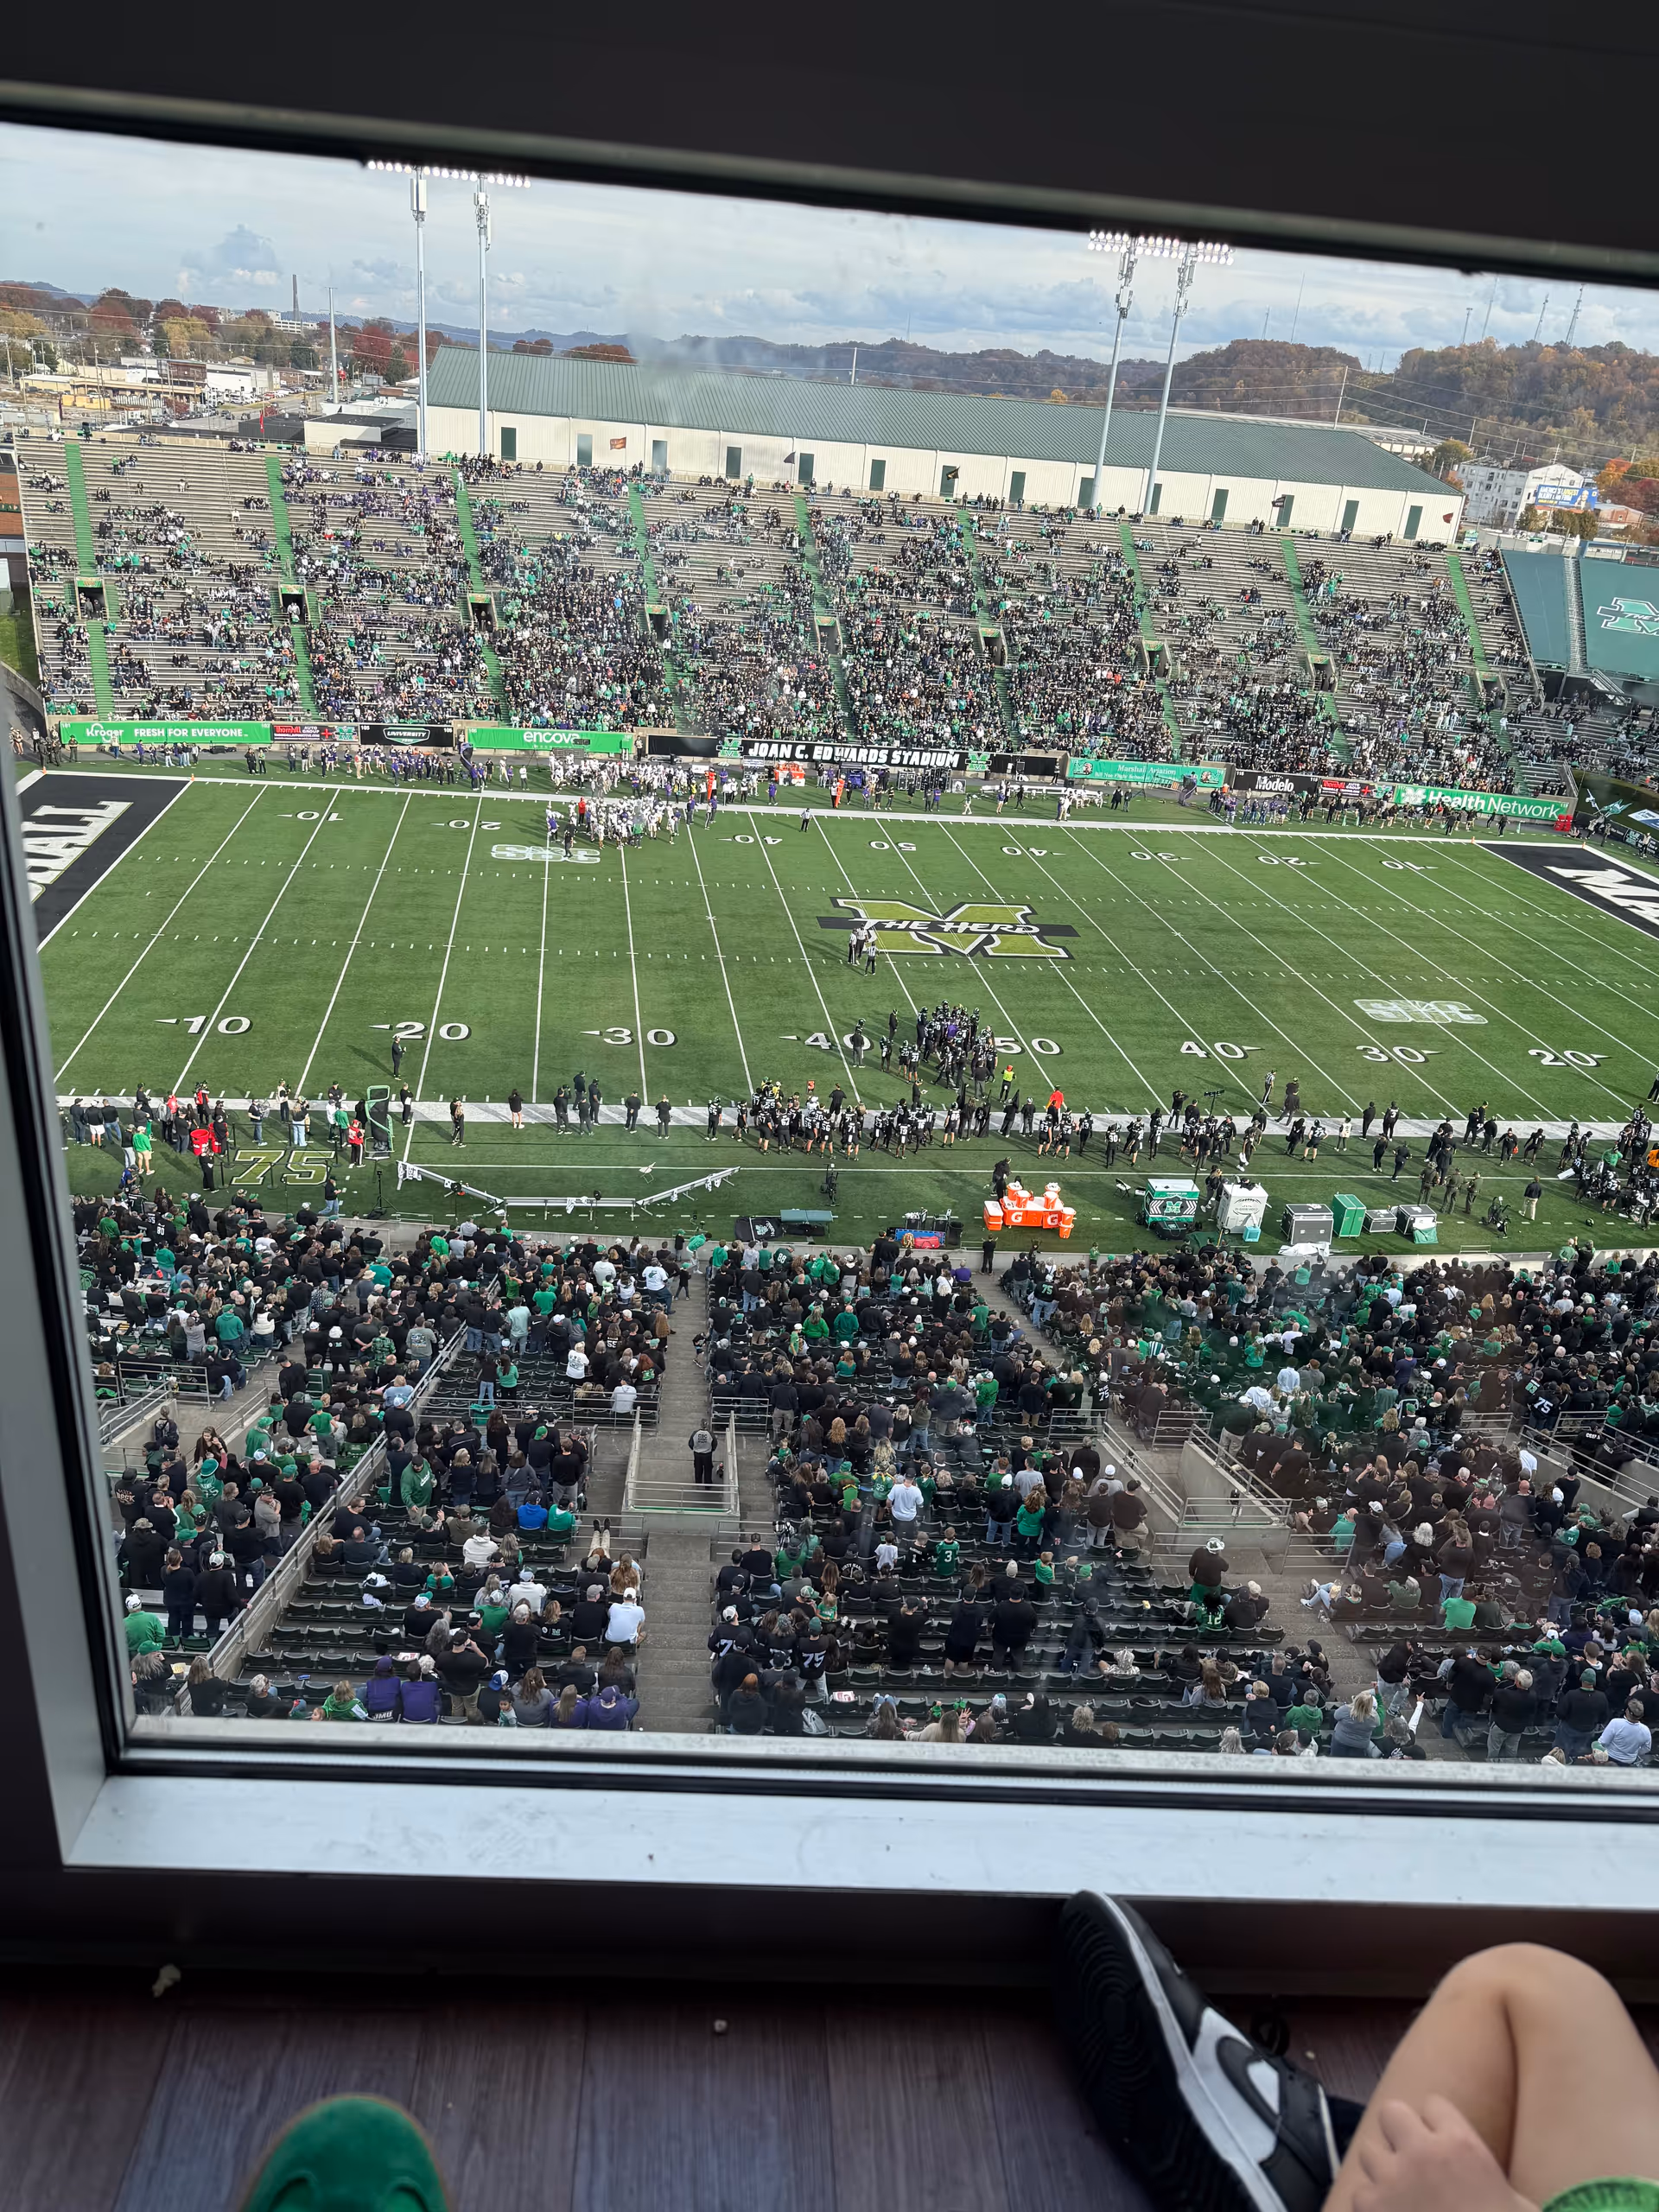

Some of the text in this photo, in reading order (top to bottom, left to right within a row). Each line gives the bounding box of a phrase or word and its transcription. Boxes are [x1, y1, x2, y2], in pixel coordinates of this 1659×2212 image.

[86, 723, 124, 742] Kroger
[134, 728, 244, 737] FRESH FOR EVERYONE
[524, 731, 580, 744] encova
[748, 742, 960, 767] JOAN C. EDWARDS STADIUM
[1255, 776, 1294, 792] Modelo
[1427, 791, 1560, 817] Health Network
[848, 918, 1040, 934] THE HERD
[231, 1149, 336, 1185] 75
[156, 1226, 165, 1236] 80
[777, 1252, 786, 1263] 88
[1041, 1284, 1053, 1295] 75
[1098, 1389, 1109, 1402] 75
[1534, 1396, 1554, 1414] 75
[944, 1550, 953, 1563] 3
[802, 1650, 826, 1669] 75
